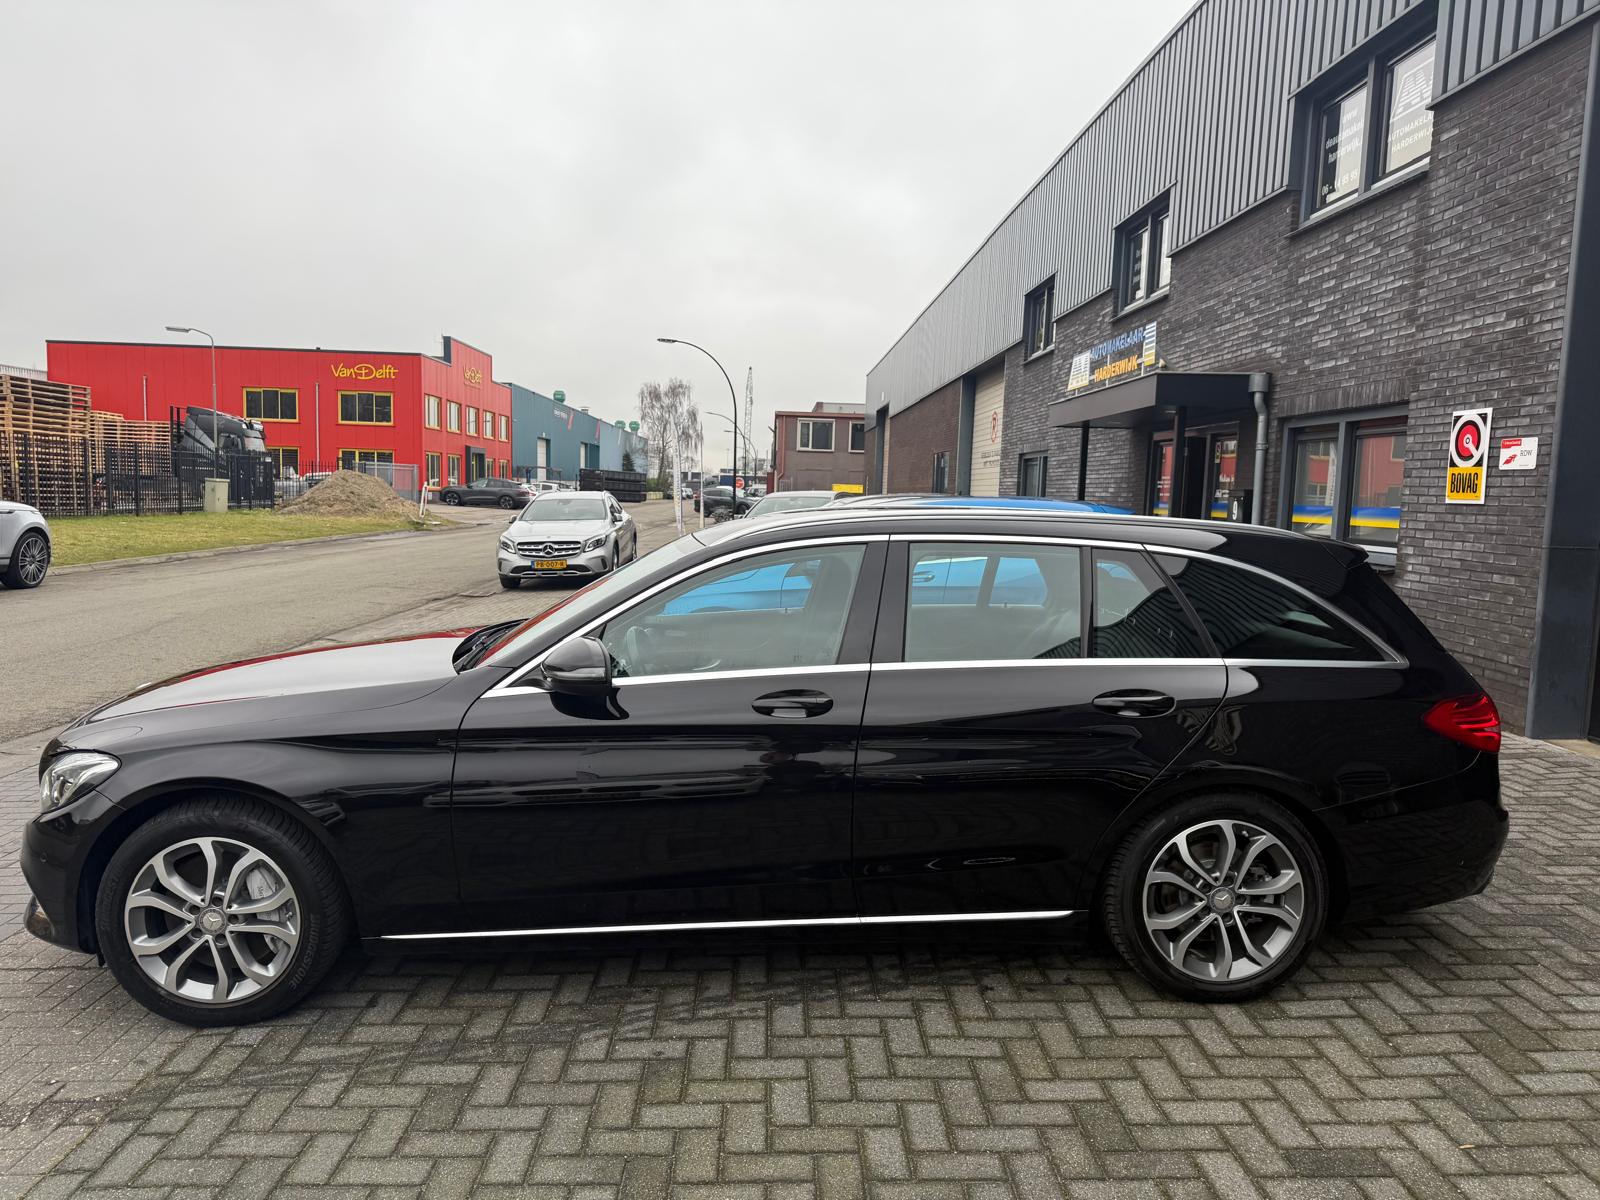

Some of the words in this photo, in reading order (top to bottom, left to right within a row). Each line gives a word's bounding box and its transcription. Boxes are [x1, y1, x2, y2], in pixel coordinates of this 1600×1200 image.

[1089, 326, 1144, 361] AUTOMAKELAAR
[1094, 355, 1138, 383] HARDERWIJK
[1450, 472, 1479, 494] BOVAG
[1232, 501, 1238, 520] 9
